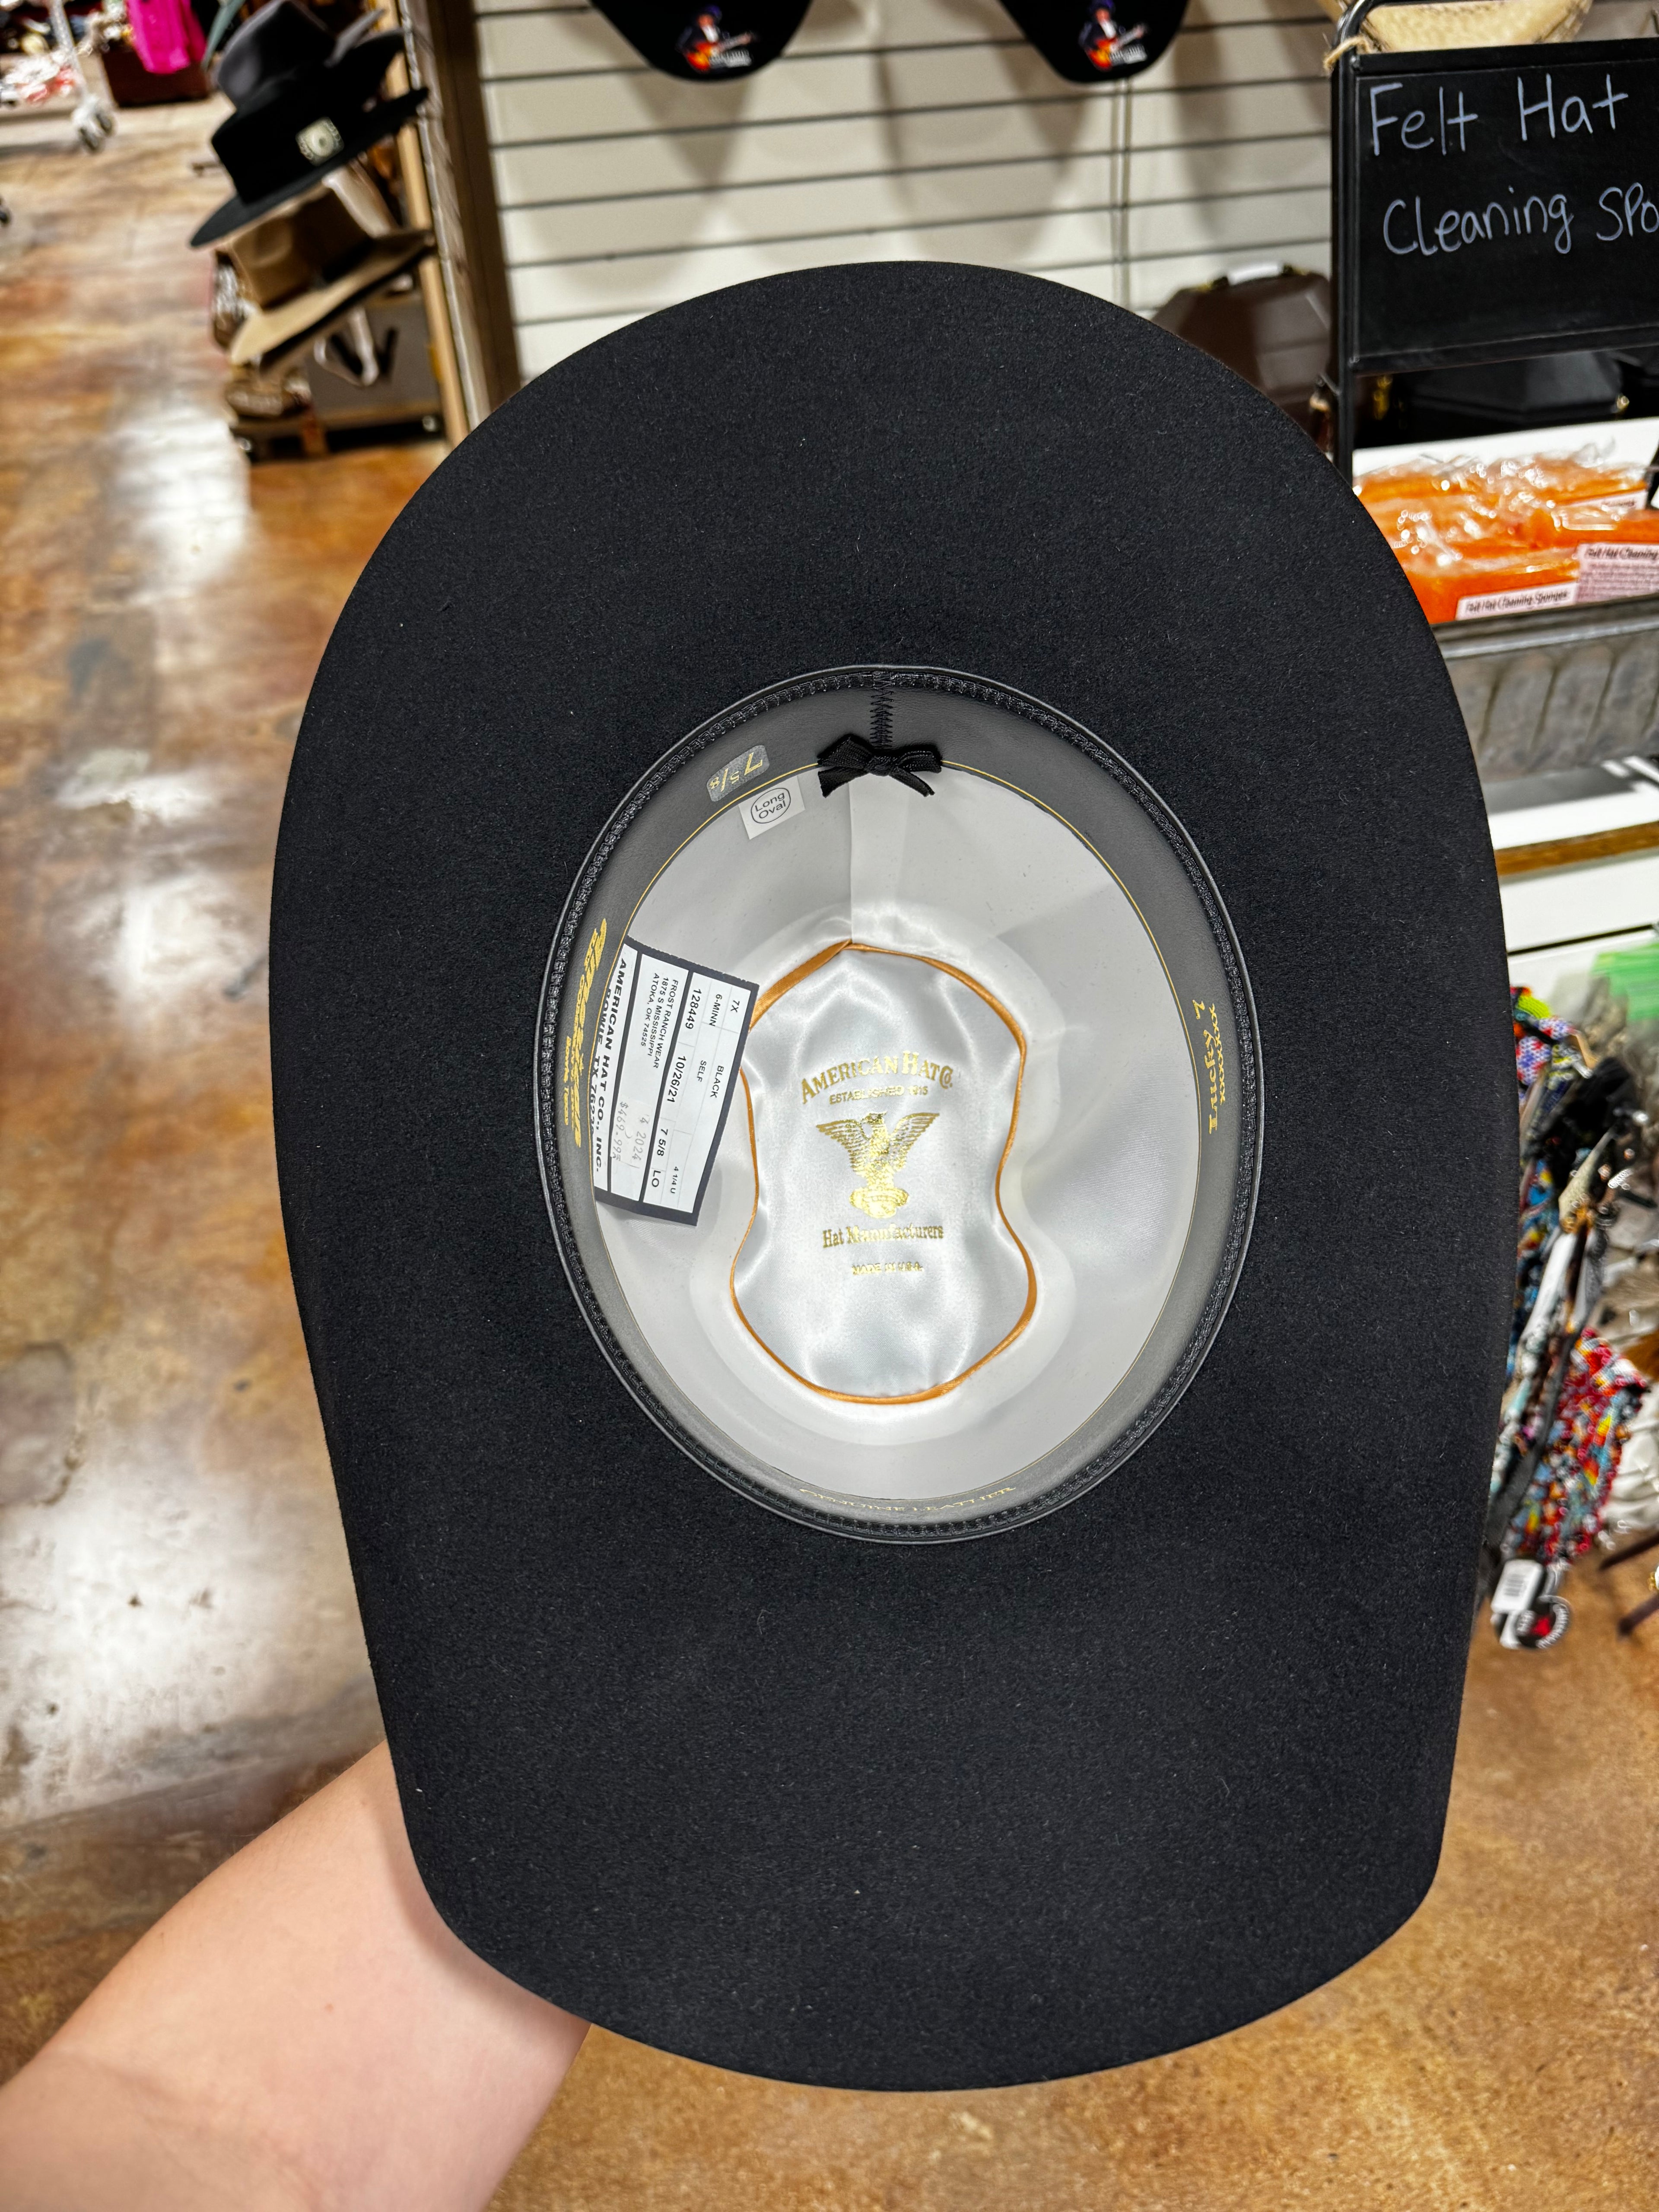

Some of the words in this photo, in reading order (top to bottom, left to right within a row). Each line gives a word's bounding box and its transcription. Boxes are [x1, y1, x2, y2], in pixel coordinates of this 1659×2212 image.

[1370, 82, 1478, 156] Felt
[1517, 73, 1629, 141] Hat
[1383, 185, 1574, 256] Cleaning
[754, 792, 785, 813] Long
[758, 800, 786, 820] Oval
[647, 973, 660, 1004] ATOKA,
[660, 977, 669, 995] 1875
[667, 979, 678, 1009] FROST
[605, 958, 626, 1050] AMERICAN
[645, 1008, 652, 1021] OK
[686, 989, 702, 1029] 128449
[709, 994, 722, 1027] 6-MINN
[731, 1000, 740, 1013] 7X
[641, 1023, 649, 1047] 74525
[648, 1005, 662, 1056] MISSISSIPPI
[659, 1010, 671, 1041] RANCH
[592, 1056, 600, 1078] TX
[653, 1043, 663, 1068] WEAR
[601, 1055, 610, 1091] HAT
[667, 1056, 686, 1103] 10/26/21
[697, 1060, 706, 1082] SELF
[710, 1065, 724, 1098] BLACK
[801, 1056, 899, 1105] AMERICAN
[1203, 1029, 1217, 1134] Lucky
[829, 1085, 905, 1105] ESTABLISHED
[632, 1131, 646, 1160] 2024
[657, 1138, 666, 1157] 5/8
[652, 1170, 661, 1187] LO
[823, 1228, 844, 1248] Hat
[845, 1223, 944, 1244] Manufacturers
[852, 1263, 881, 1275] MADE
[885, 1262, 896, 1273] IN
